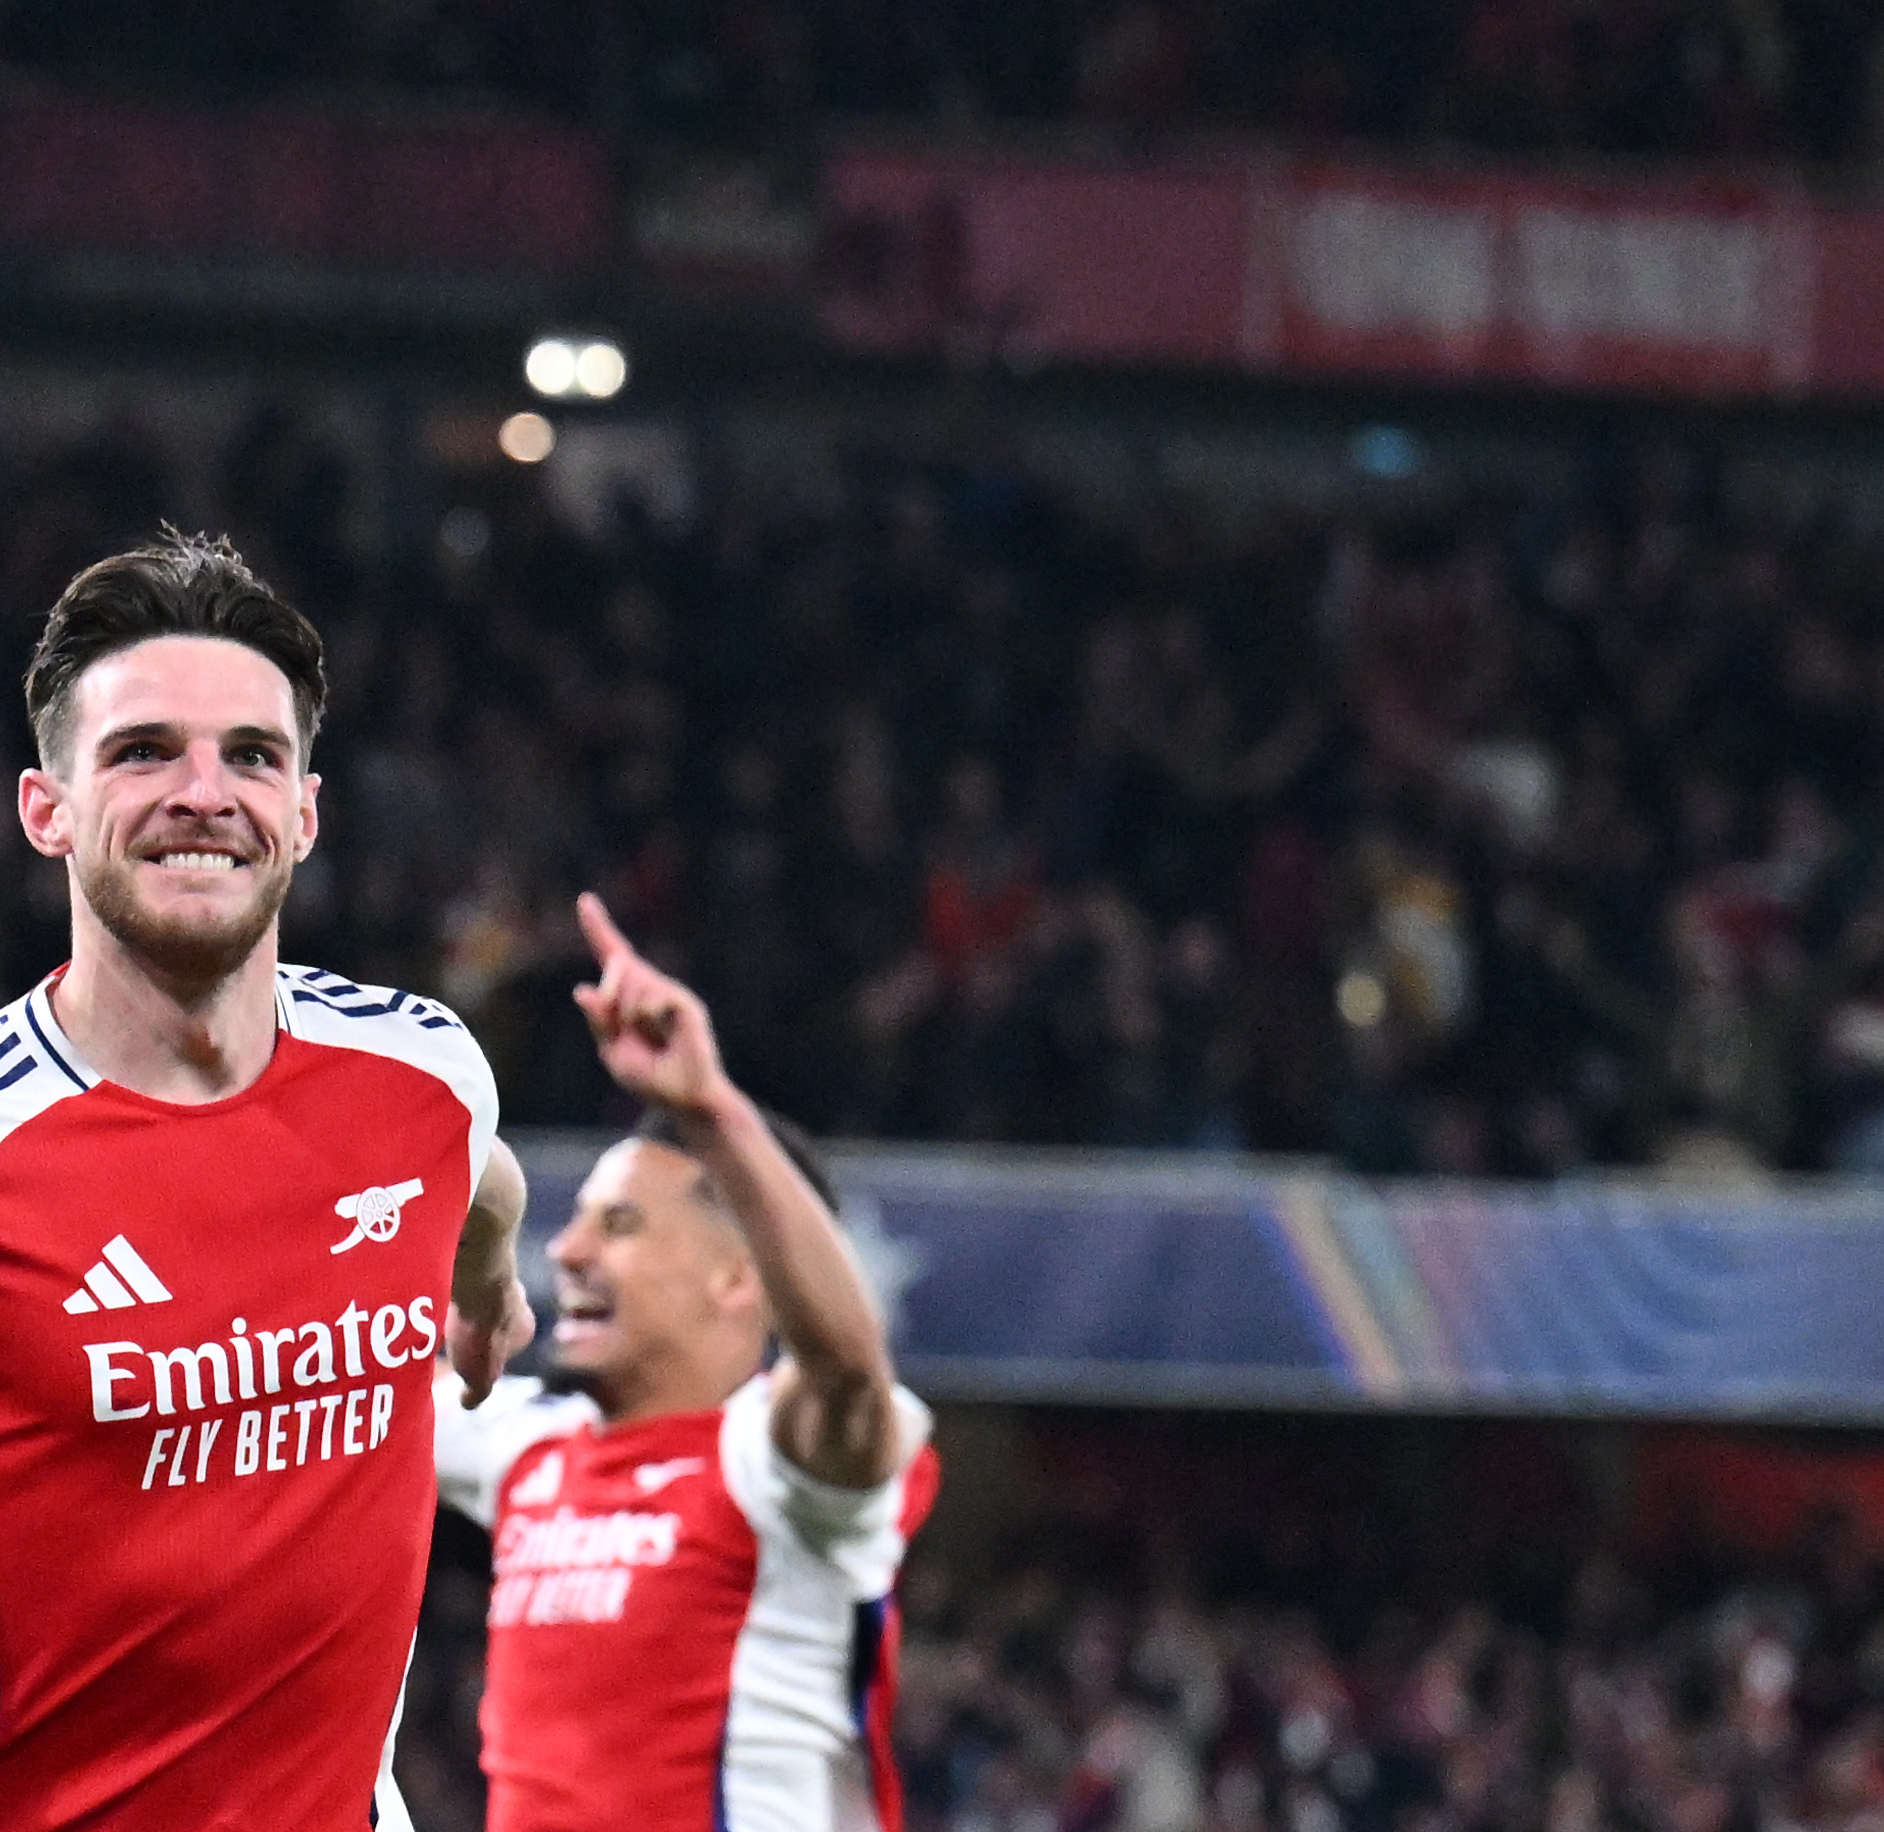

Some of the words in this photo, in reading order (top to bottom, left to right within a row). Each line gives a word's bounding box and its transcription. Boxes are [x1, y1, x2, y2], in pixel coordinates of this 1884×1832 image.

[83, 1297, 436, 1423] Emirates
[142, 1426, 223, 1491] FLY
[234, 1383, 395, 1478] BETTER
